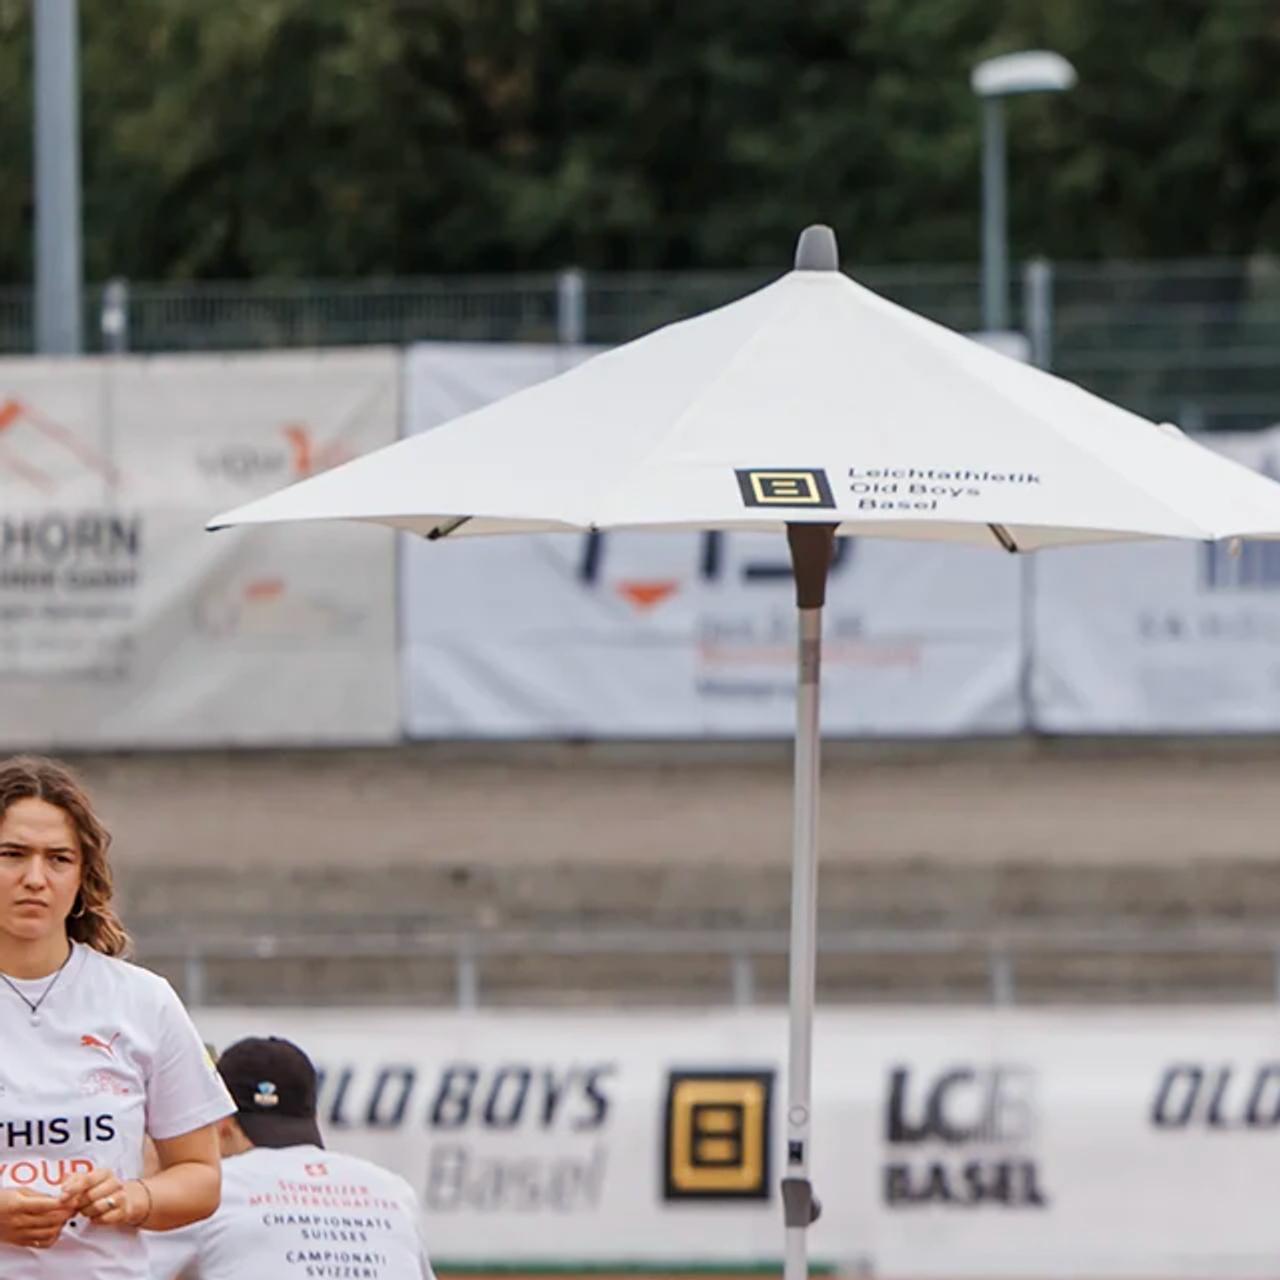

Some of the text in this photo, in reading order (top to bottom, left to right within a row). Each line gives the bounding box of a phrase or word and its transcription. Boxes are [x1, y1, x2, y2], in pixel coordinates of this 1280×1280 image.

[848, 467, 1040, 484] Leichtathletik
[849, 482, 981, 498] Old Boys
[858, 499, 938, 510] Basel
[428, 1062, 617, 1131] BOYS
[0, 1114, 116, 1147] HIS IS
[886, 1162, 1047, 1208] BASEL
[261, 1213, 392, 1231] CHAMPIONNATS
[300, 1227, 368, 1243] SUISSES
[285, 1250, 387, 1266] CAMPIONATI
[305, 1265, 378, 1280] SVIZZERI
